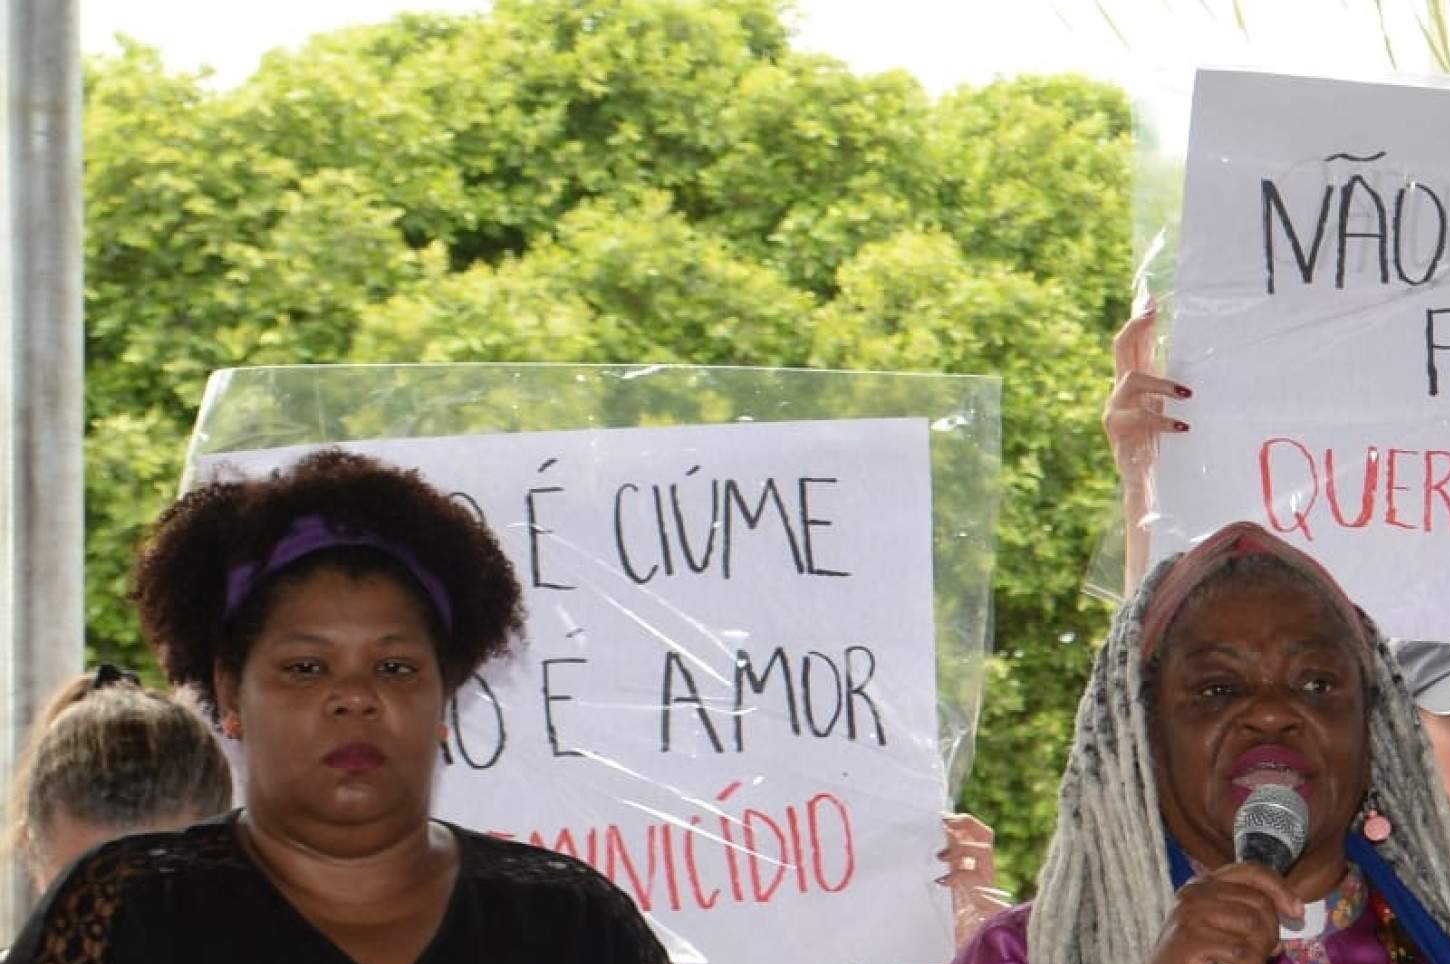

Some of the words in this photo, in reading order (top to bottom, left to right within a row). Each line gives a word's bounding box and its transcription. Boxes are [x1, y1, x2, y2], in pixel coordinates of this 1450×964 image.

[1260, 150, 1448, 294] NÃO
[526, 458, 578, 590] É
[614, 466, 851, 585] CIÚME
[541, 628, 588, 758] É
[661, 645, 886, 754] AMOR
